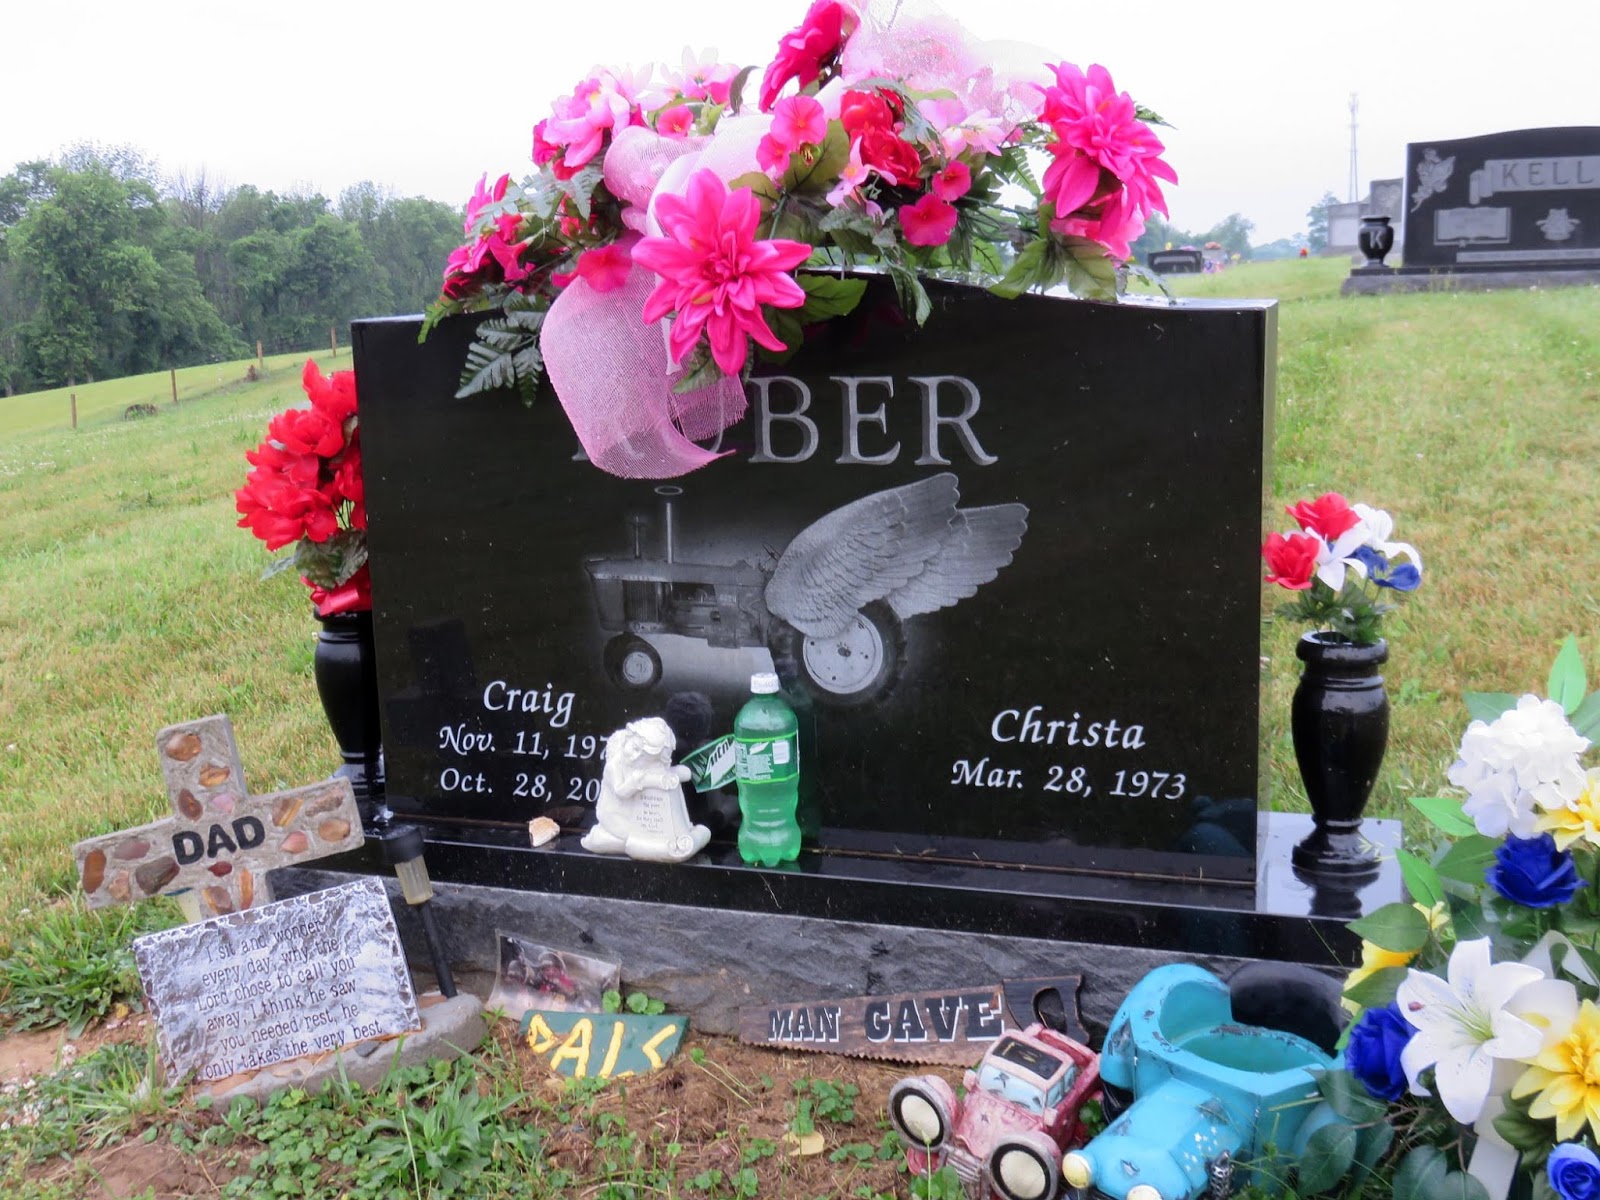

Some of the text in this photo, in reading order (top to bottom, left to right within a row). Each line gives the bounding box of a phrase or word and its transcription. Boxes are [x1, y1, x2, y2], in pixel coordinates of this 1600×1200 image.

[1370, 231, 1383, 249] K
[483, 681, 575, 728] Craig
[991, 705, 1146, 750] Christa
[439, 723, 496, 756] Nov.
[512, 730, 549, 760] 11,
[440, 768, 493, 794] Oct.
[513, 772, 552, 802] 28,
[951, 757, 1187, 800] Mar. 28, 1973
[172, 816, 265, 866] DAD
[202, 965, 240, 987] every
[281, 946, 309, 965] why
[315, 936, 340, 956] the
[218, 937, 236, 960] sit
[241, 930, 268, 954] and
[273, 918, 323, 943] wonder
[197, 956, 356, 1012] Lord chose to call you
[262, 991, 303, 1017] think
[308, 986, 327, 1004] he
[330, 979, 356, 998] saw
[219, 1036, 246, 1056] you
[251, 1017, 299, 1043] needed
[341, 1002, 360, 1018] he
[767, 992, 1005, 1043] MAN CAVE
[205, 1019, 383, 1080] only takes the very best
